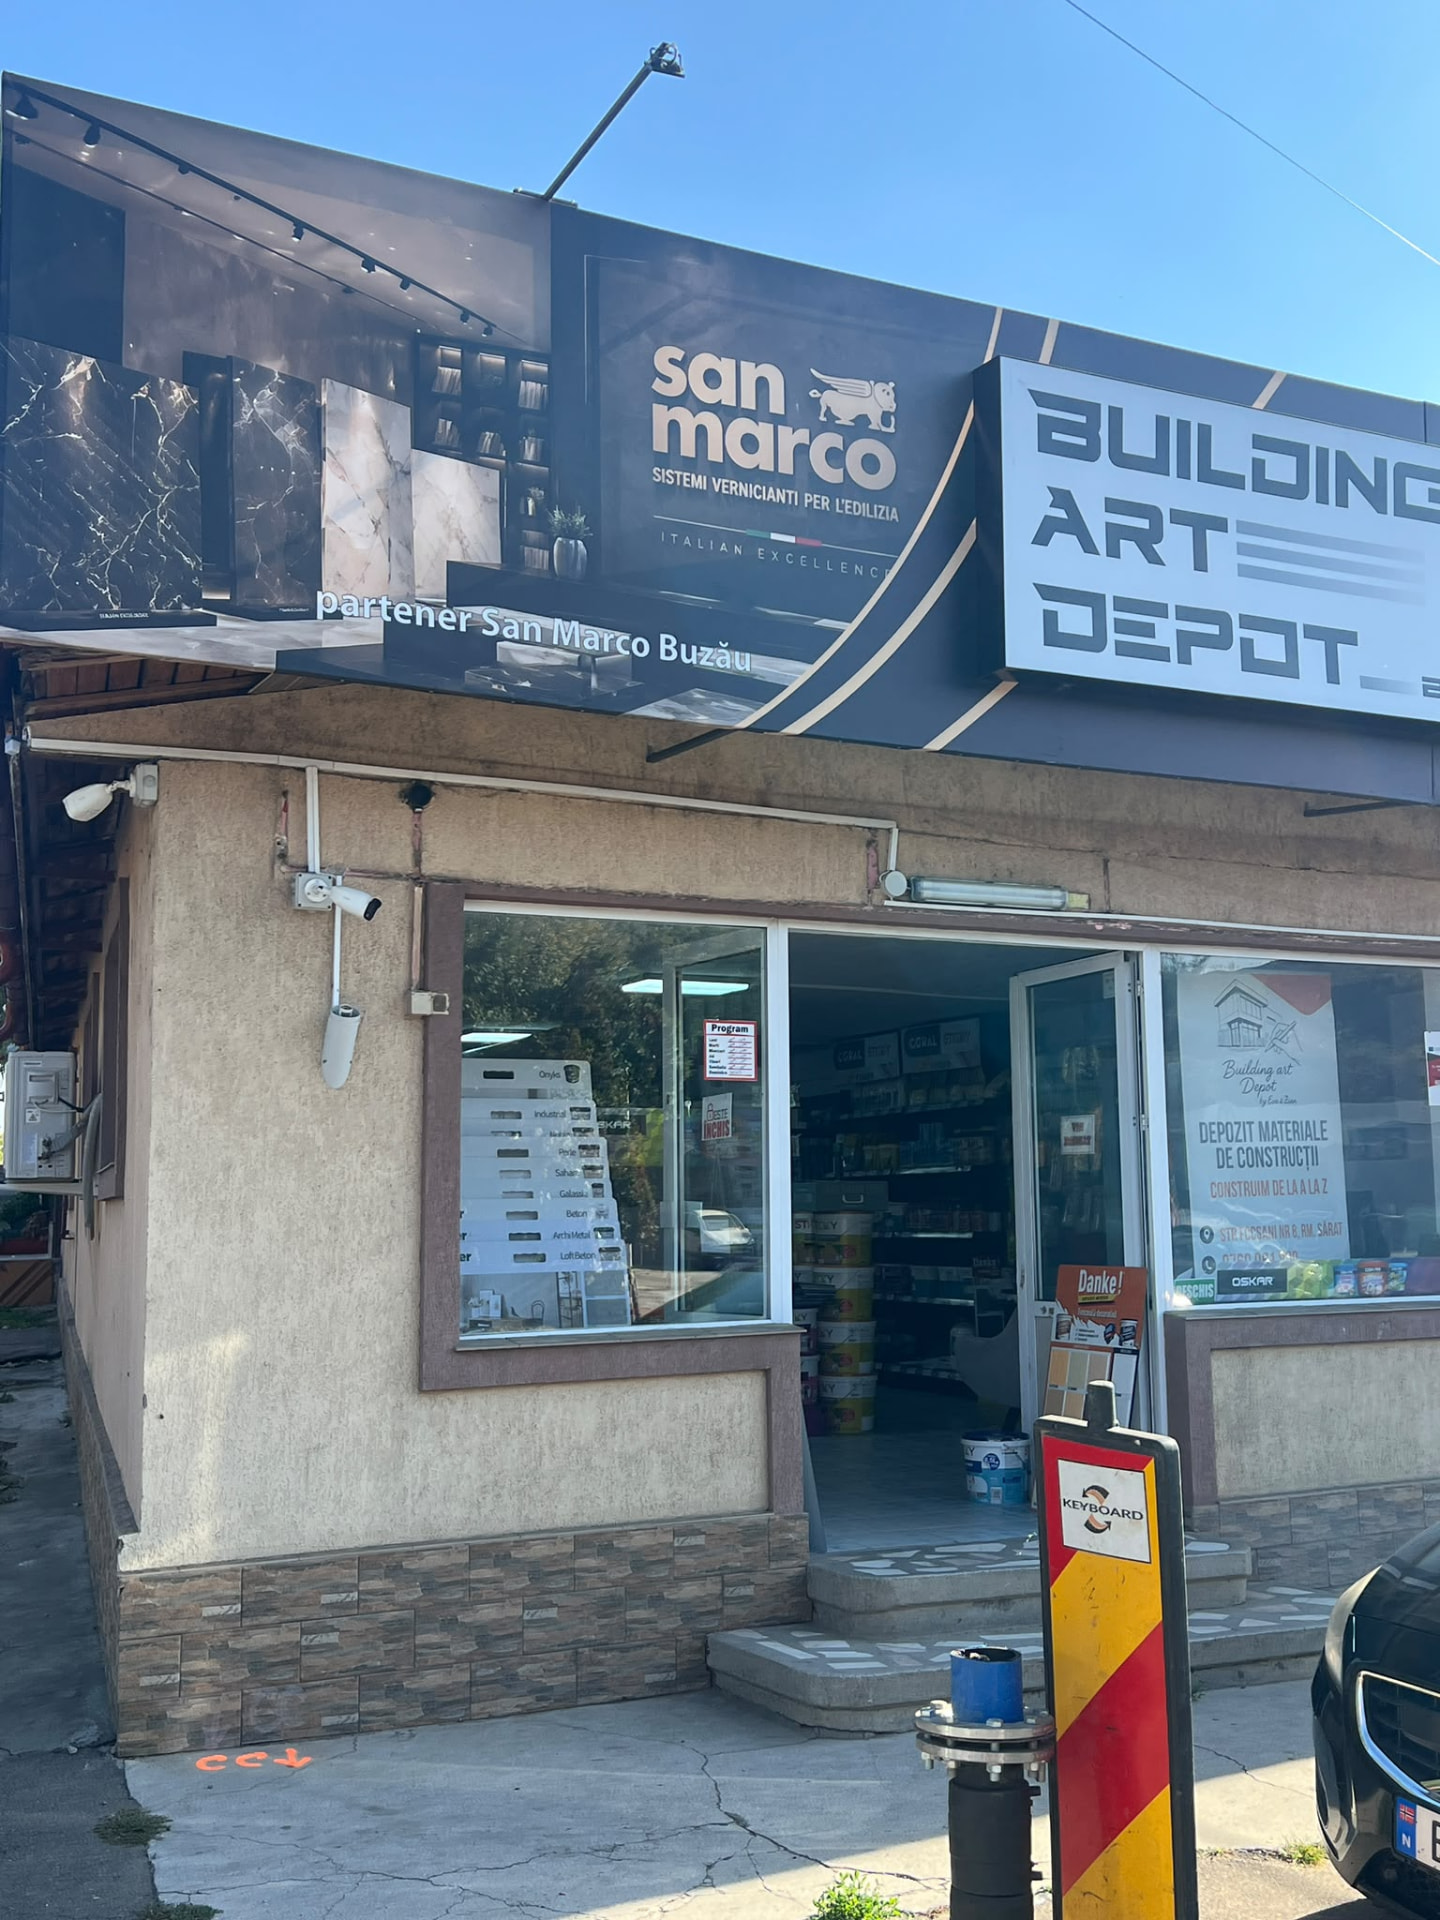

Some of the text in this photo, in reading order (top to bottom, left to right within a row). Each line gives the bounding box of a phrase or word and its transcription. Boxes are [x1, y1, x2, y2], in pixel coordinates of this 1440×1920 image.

[652, 346, 785, 415] san
[652, 403, 897, 491] marco
[1028, 388, 1440, 525] BUILDING
[652, 467, 899, 522] SISTEMI VERNICIANTI PER L'EDILIZIA
[1031, 485, 1228, 573] ART
[661, 531, 743, 555] ITALIAN
[316, 590, 752, 672] partener San Marco Buzău
[1033, 582, 1358, 685] DEPOT
[711, 1023, 749, 1034] Program
[1222, 1059, 1293, 1081] Building art
[1240, 1077, 1277, 1097] Depot
[1199, 1120, 1329, 1143] DEPOZIT MATERIALE
[1216, 1145, 1319, 1171] DE CONSTRUCȚII
[1210, 1178, 1328, 1198] CONSTRUIM DE LA A LA Z
[566, 1210, 588, 1218] Beton
[1078, 1269, 1124, 1294] Danke!
[1232, 1276, 1274, 1287] OSKAR
[1062, 1498, 1144, 1521] KEYBOARD
[1402, 1833, 1411, 1849] N
